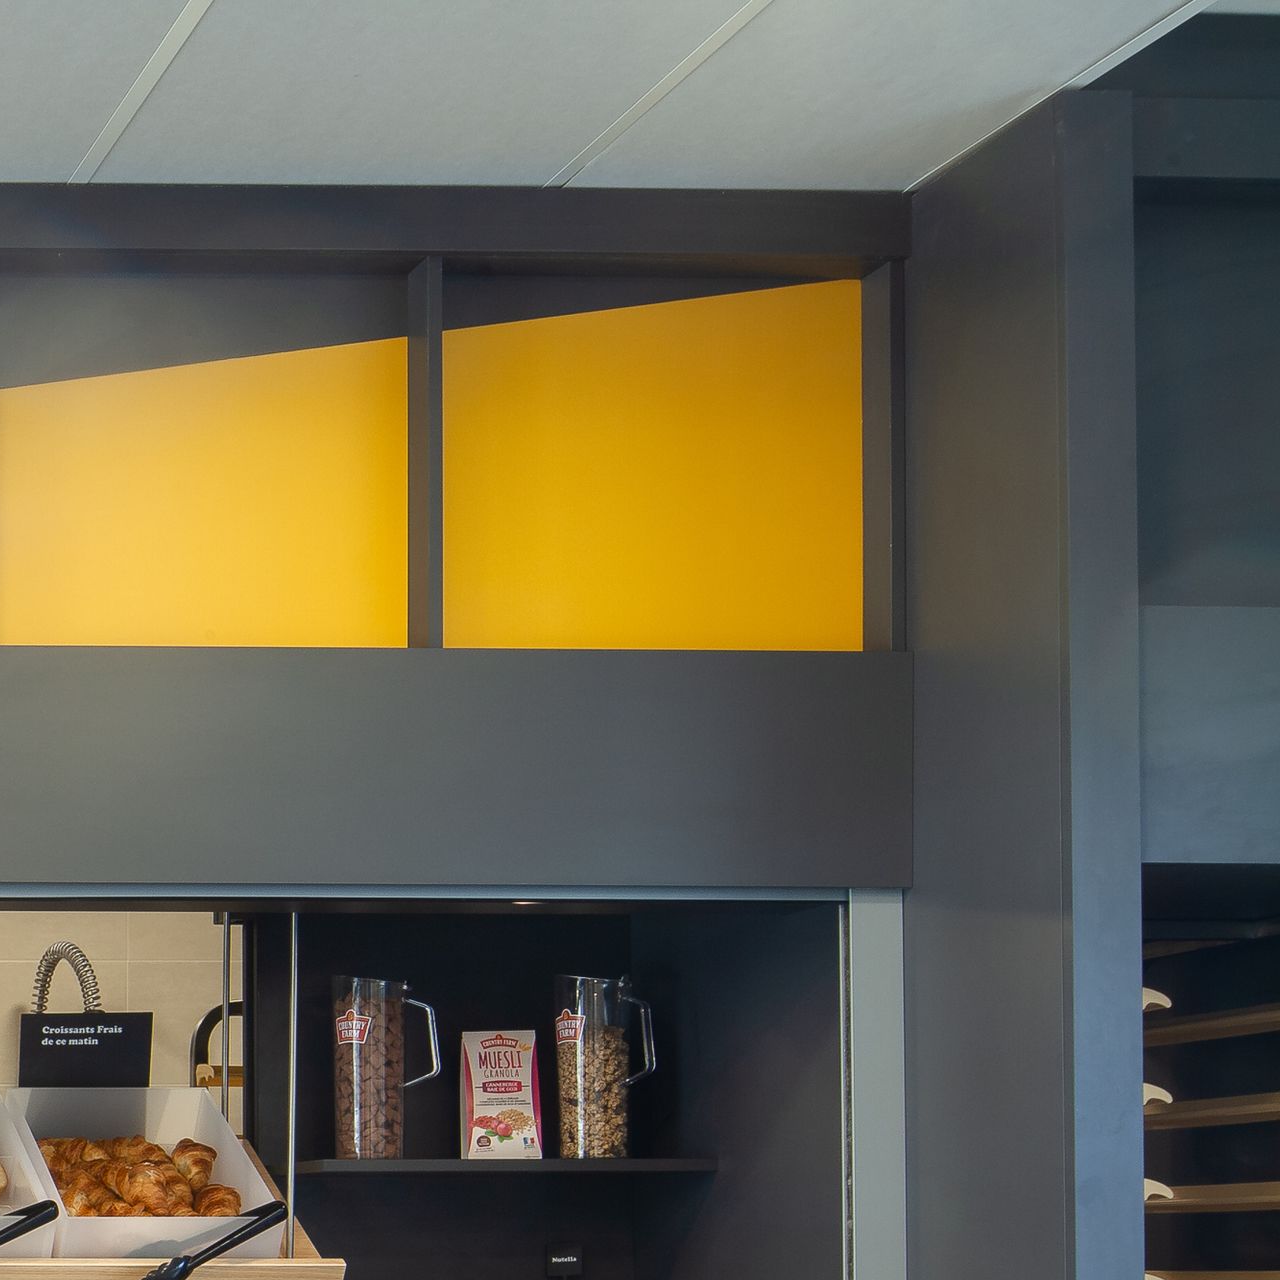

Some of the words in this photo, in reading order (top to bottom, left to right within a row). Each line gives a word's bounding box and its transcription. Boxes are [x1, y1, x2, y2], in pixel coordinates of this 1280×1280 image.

[42, 1025, 95, 1034] Croissants
[96, 1025, 123, 1034] Frais
[41, 1037, 54, 1046] de
[55, 1038, 67, 1046] ce
[68, 1037, 99, 1046] matin
[478, 1050, 523, 1069] MUESLI
[483, 1069, 520, 1078] GRANOLA
